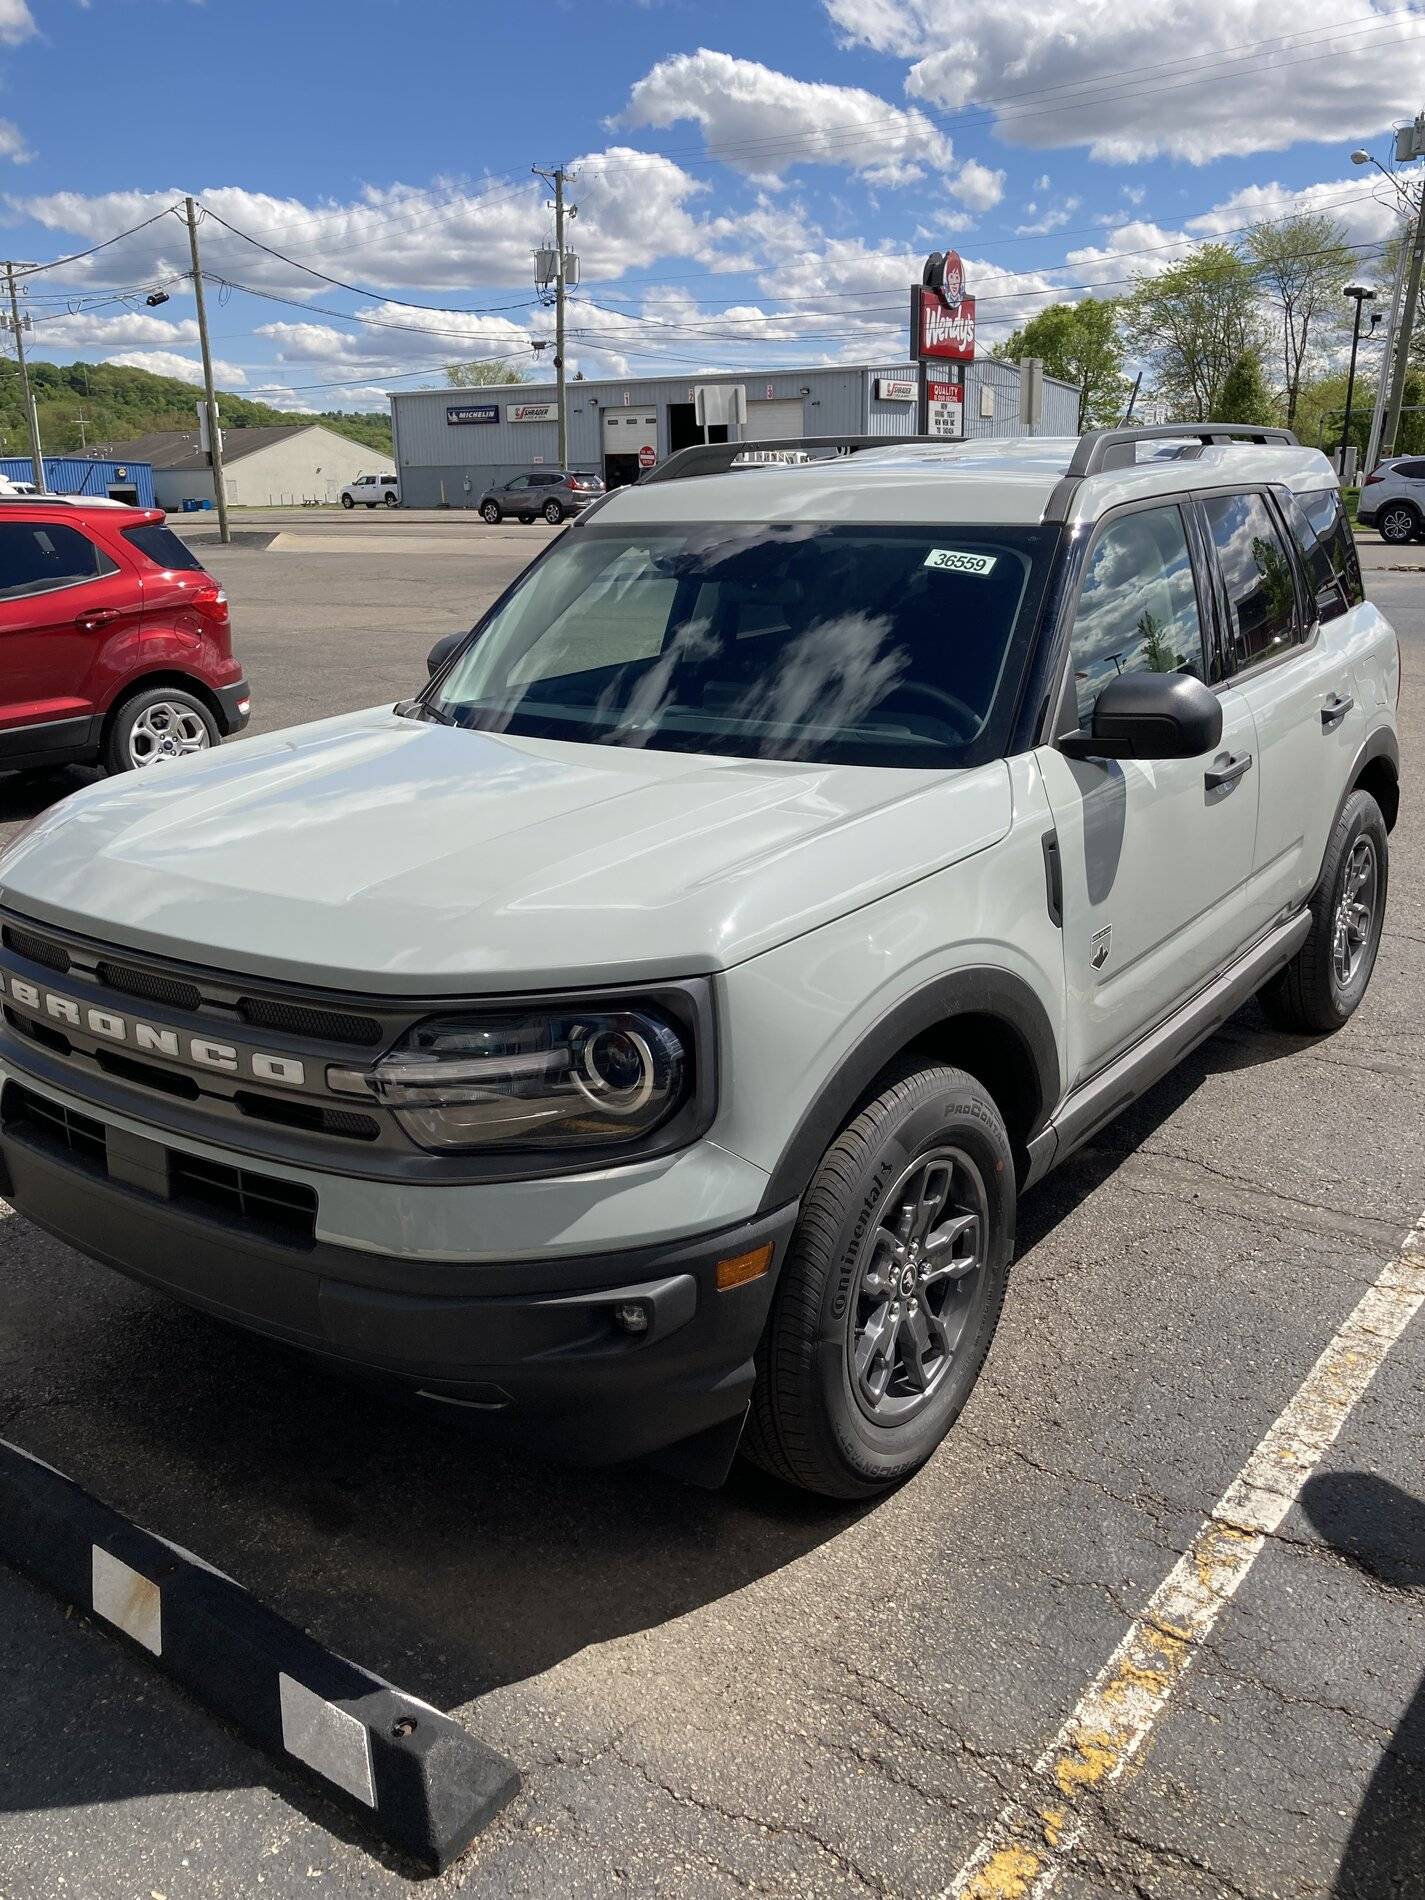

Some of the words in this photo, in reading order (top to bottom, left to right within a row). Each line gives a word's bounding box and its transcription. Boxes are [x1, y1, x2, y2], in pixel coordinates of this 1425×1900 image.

[925, 304, 975, 352] Wendy's
[933, 385, 959, 396] QUALITY
[458, 409, 495, 419] MICHELIN
[524, 408, 549, 416] SHRADER
[933, 553, 987, 572] 36559
[11, 978, 305, 1085] BRONCO
[831, 1174, 885, 1320] Continental
